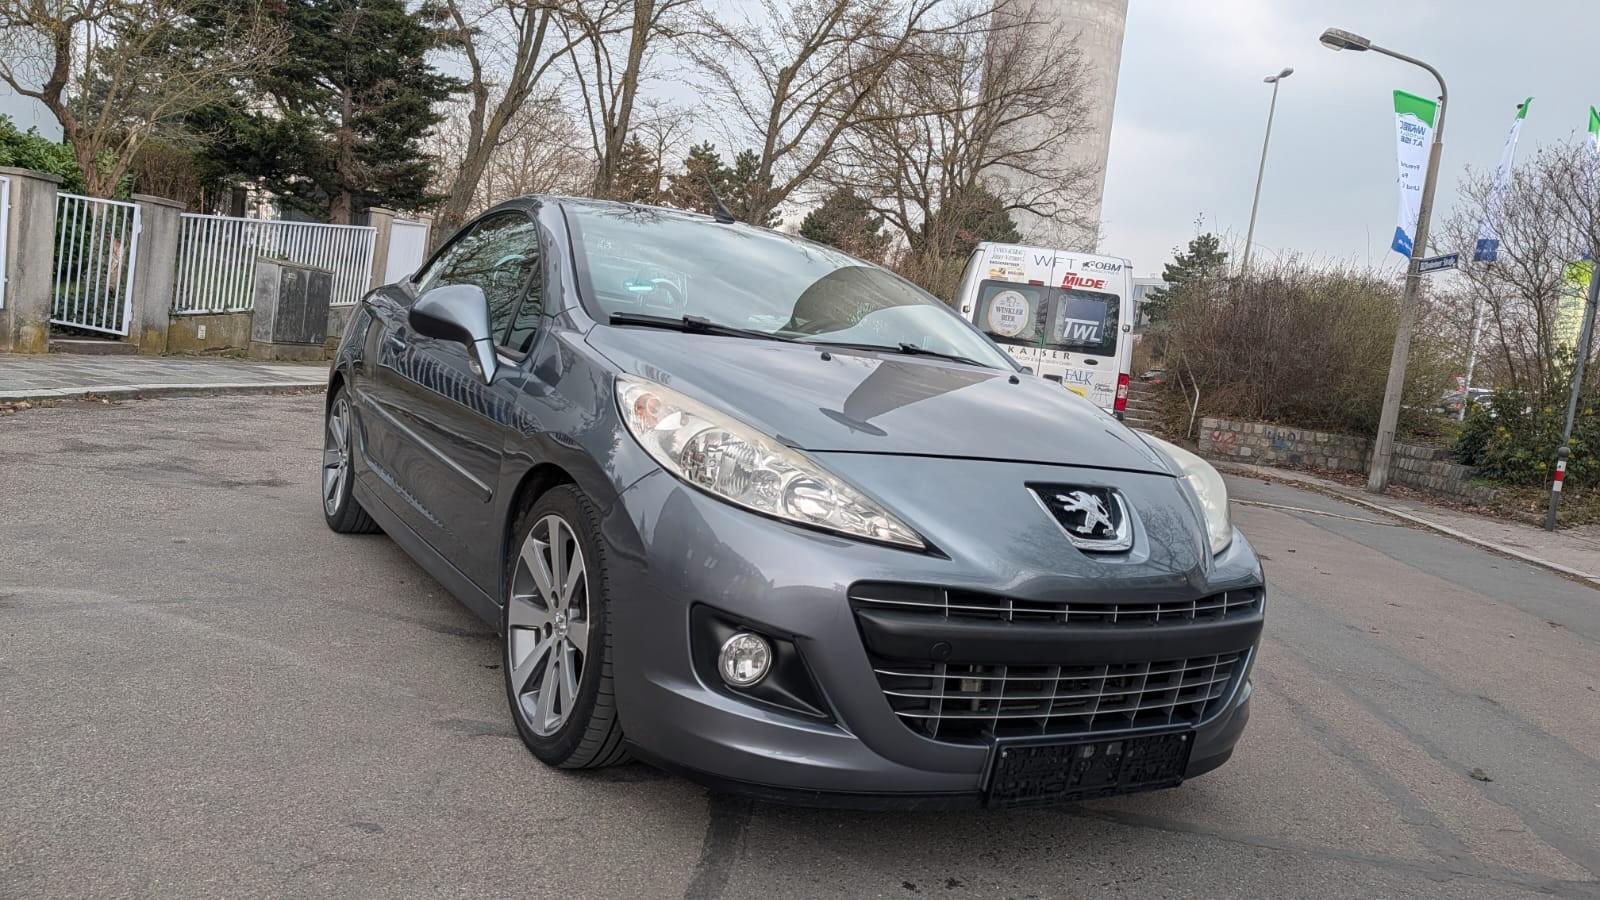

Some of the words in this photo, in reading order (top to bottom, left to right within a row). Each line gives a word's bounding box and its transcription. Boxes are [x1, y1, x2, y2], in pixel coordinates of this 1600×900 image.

[1034, 254, 1077, 270] WFT
[1062, 275, 1106, 289] MILDE
[1063, 317, 1101, 342] TWL
[1007, 345, 1071, 360] KAISER
[1065, 369, 1094, 386] FALK
